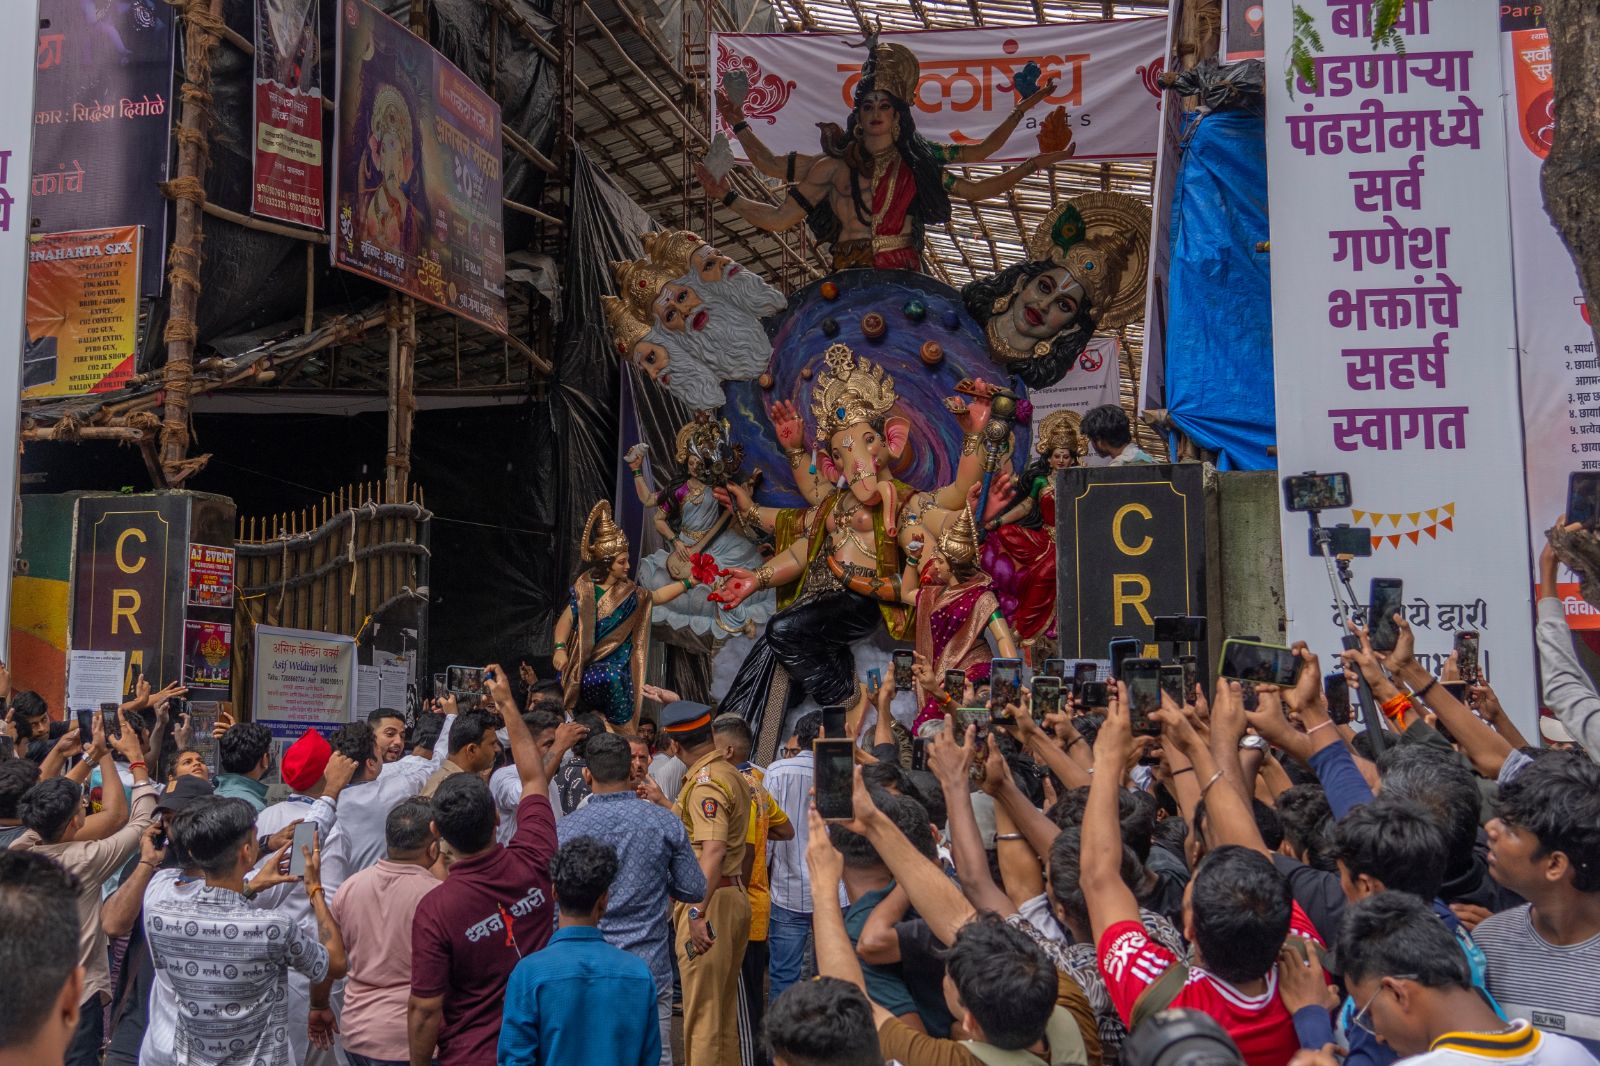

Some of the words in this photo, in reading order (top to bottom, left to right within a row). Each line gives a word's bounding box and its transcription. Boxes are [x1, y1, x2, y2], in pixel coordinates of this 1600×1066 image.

[73, 100, 114, 123] सिद्धेश
[119, 94, 165, 119] दिघोळे
[1026, 114, 1091, 129] ats
[1349, 155, 1425, 212] सर्व
[105, 241, 133, 256] SFX
[1329, 215, 1451, 271] गणेश
[1328, 273, 1462, 330] भक्तांचे
[1341, 332, 1450, 391] सहर्ष
[1328, 406, 1468, 452] स्वागत
[1436, 598, 1488, 632] द्वारी
[272, 660, 289, 674] Asif
[289, 661, 318, 675] Welding
[320, 663, 338, 674] Work
